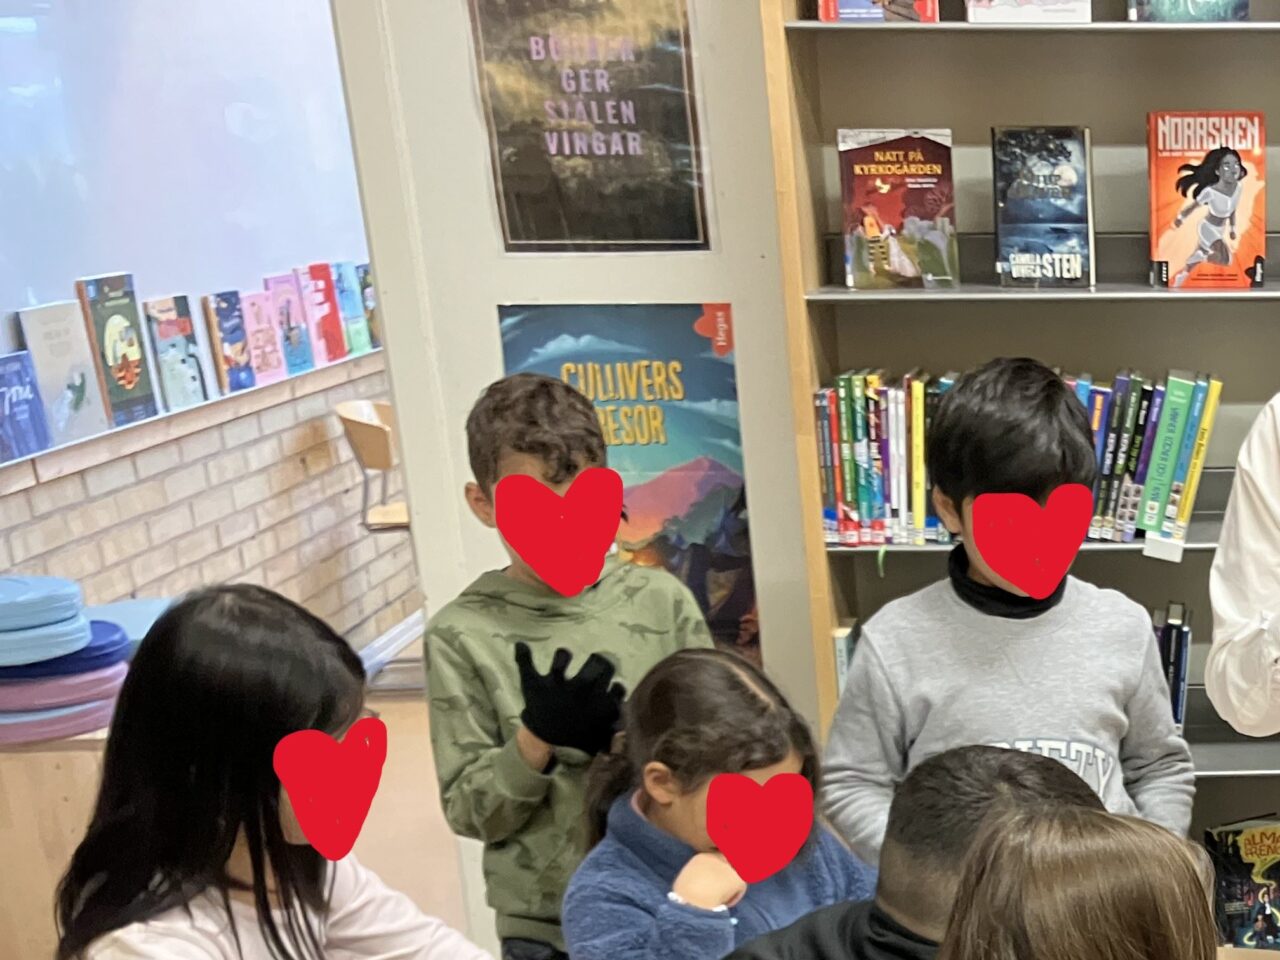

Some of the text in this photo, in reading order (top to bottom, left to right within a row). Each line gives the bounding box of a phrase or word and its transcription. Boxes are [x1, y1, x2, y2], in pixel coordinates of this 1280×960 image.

[560, 68, 611, 93] GER
[545, 131, 643, 156] VINGAR
[1157, 115, 1260, 150] NORRSKEN
[874, 148, 924, 162] NATT PÅ
[854, 161, 943, 175] KYRKOGÅRDEN
[1042, 253, 1082, 279] STEN
[715, 311, 728, 346] Hegas
